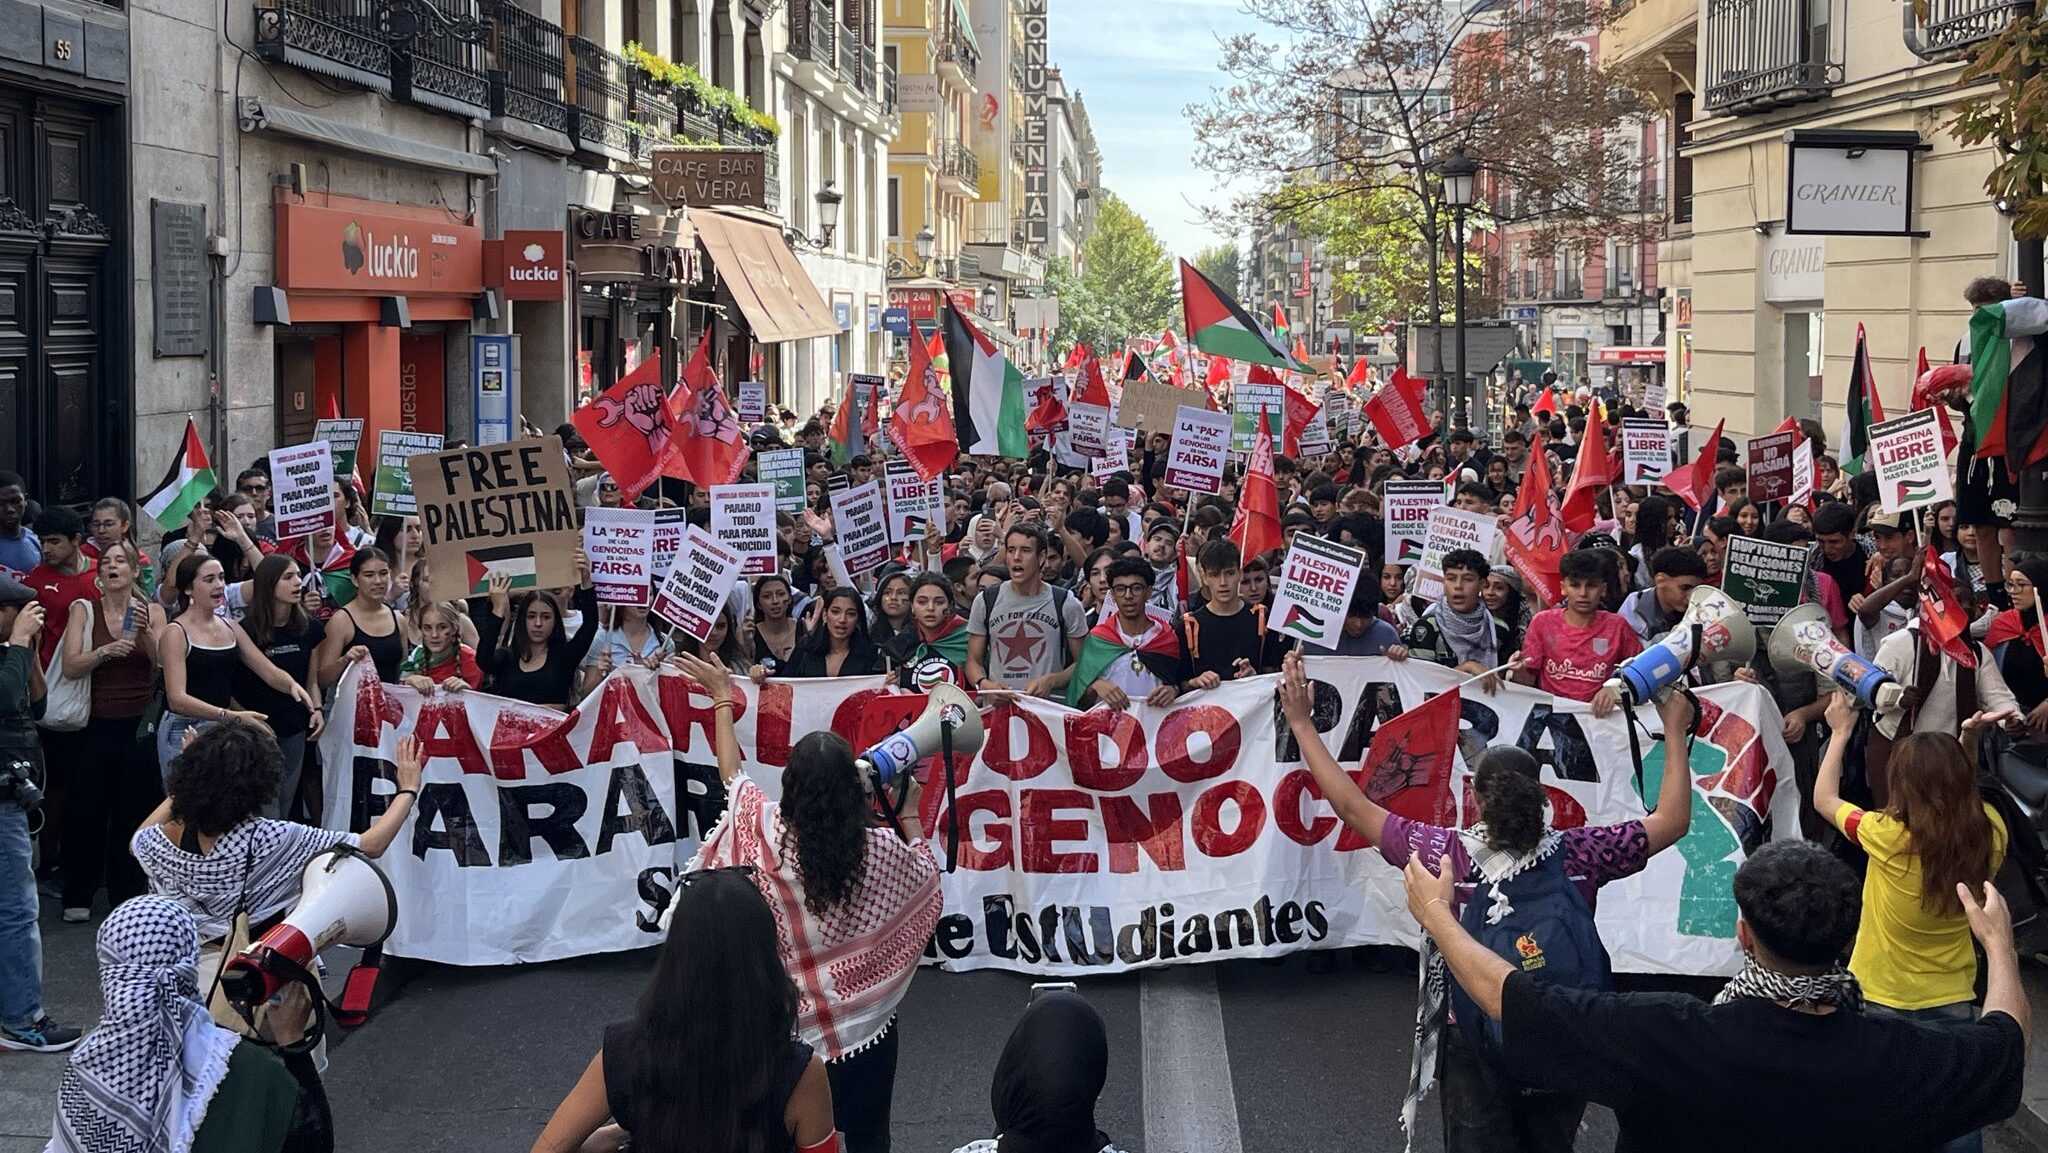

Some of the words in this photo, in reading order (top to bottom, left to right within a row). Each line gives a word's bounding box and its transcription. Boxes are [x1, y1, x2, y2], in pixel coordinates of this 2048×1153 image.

[55, 40, 71, 60] 55
[1025, 0, 1047, 242] MONUMENTAL
[658, 158, 707, 179] CAFE
[719, 158, 755, 175] BAR
[664, 182, 687, 200] LA
[696, 180, 751, 199] VERA
[1796, 183, 1899, 206] GRANIER
[578, 212, 641, 240] CAFE
[368, 232, 419, 278] luckia
[1769, 246, 1824, 280] GRANIE
[510, 266, 558, 281] luckia
[913, 292, 930, 302] 24h
[1235, 386, 1270, 396] RUPTURA
[1235, 395, 1282, 405] RELACIONES
[1236, 404, 1257, 413] CON
[1181, 423, 1193, 432] LA
[1627, 432, 1665, 440] PALESTINA
[382, 434, 428, 446] RUPTURA
[430, 439, 441, 448] DE
[1073, 434, 1101, 444] FARSA
[1180, 439, 1221, 451] GENOCIDAS
[1628, 440, 1666, 450] LIBRE
[1750, 441, 1758, 450] EL
[1876, 428, 1933, 450] PALESTINA
[760, 452, 791, 462] RUPTURA
[793, 451, 802, 459] DE
[1176, 452, 1218, 469] FARSA
[1763, 447, 1778, 460] NO
[1879, 438, 1936, 466] LIBRE
[285, 461, 320, 476] PARARLO
[440, 447, 547, 495] FREE
[759, 460, 801, 470] RELACIONES
[1097, 459, 1123, 471] FARSA
[1751, 454, 1790, 475] PASARÁ
[1882, 461, 1910, 474] DESDE
[1912, 459, 1922, 467] EL
[1924, 454, 1938, 464] RIO
[1884, 469, 1909, 481] HASTA
[1910, 466, 1920, 474] EL
[1921, 461, 1940, 472] MAR
[294, 475, 315, 488] TODO
[761, 470, 776, 479] CON
[777, 468, 801, 477] ISRAEL
[281, 490, 303, 502] PARA
[303, 484, 328, 498] PARAR
[892, 483, 938, 499] LIBRE
[280, 504, 288, 514] EL
[289, 496, 330, 513] GENOCIDIO
[724, 502, 761, 514] PARARLO
[845, 501, 873, 518] PARARLO
[1390, 498, 1440, 506] PALESTINA
[424, 489, 574, 545] PALESTINA
[732, 515, 755, 526] TODO
[853, 514, 870, 527] TODO
[1391, 508, 1429, 521] LIBR
[1433, 514, 1476, 532] HUELGA
[592, 526, 607, 537] LA
[718, 529, 740, 539] PARA
[741, 528, 769, 538] PARAR
[844, 529, 862, 543] PARA
[862, 521, 882, 537] PARAR
[1431, 525, 1481, 543] GENERAL
[592, 545, 645, 555] GENOCIDAS
[844, 543, 852, 555] EL
[852, 532, 884, 553] GENOCIDIO
[1429, 535, 1461, 547] CONTRA
[1463, 542, 1472, 550] EL
[1731, 539, 1787, 559] RUPTURA
[1789, 550, 1805, 561] DE
[591, 561, 643, 576] FARSA
[689, 548, 724, 575] PARARLO
[1292, 553, 1350, 580] PALESTINA
[1730, 553, 1802, 573] RELACIONES
[690, 565, 712, 584] TODO
[1288, 565, 1348, 597] LIBRE
[1730, 563, 1756, 578] CON
[1757, 568, 1798, 583] ISRAEL
[673, 570, 692, 588] PARA
[691, 579, 719, 603] PARAR
[1285, 582, 1314, 597] DESDE
[1315, 590, 1325, 600] EL
[1327, 594, 1342, 606] RIO
[665, 581, 675, 593] EL
[673, 585, 716, 616] GENOCIDIO
[1283, 590, 1309, 606] HASTA
[1309, 597, 1320, 607] EL
[1321, 601, 1341, 614] MAR
[350, 756, 728, 868] PARAR
[1428, 831, 1446, 873] NEVER
[926, 913, 975, 959] e
